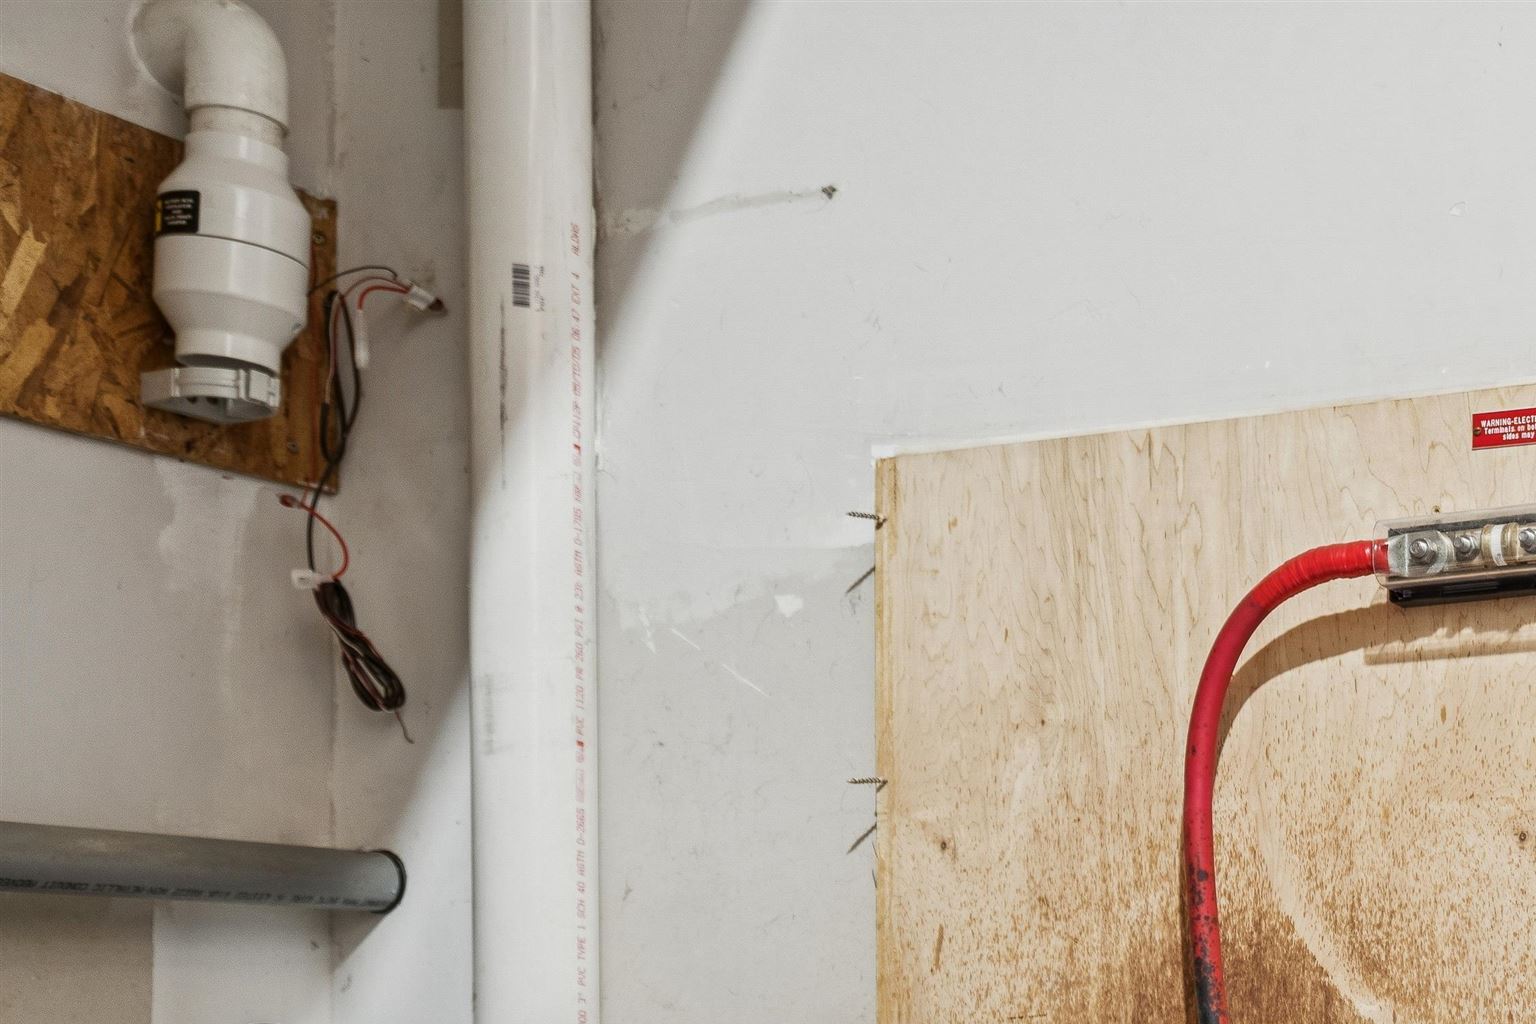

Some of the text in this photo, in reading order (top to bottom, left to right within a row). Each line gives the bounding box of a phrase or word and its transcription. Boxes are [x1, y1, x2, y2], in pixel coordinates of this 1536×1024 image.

[1502, 432, 1519, 440] sides
[574, 550, 583, 577] ASTM
[576, 808, 585, 846] D-2665
[576, 851, 585, 877] ASTM
[576, 882, 586, 895] 40
[576, 899, 586, 920] SCH
[576, 936, 586, 960] TYPE
[576, 966, 586, 987] PVC
